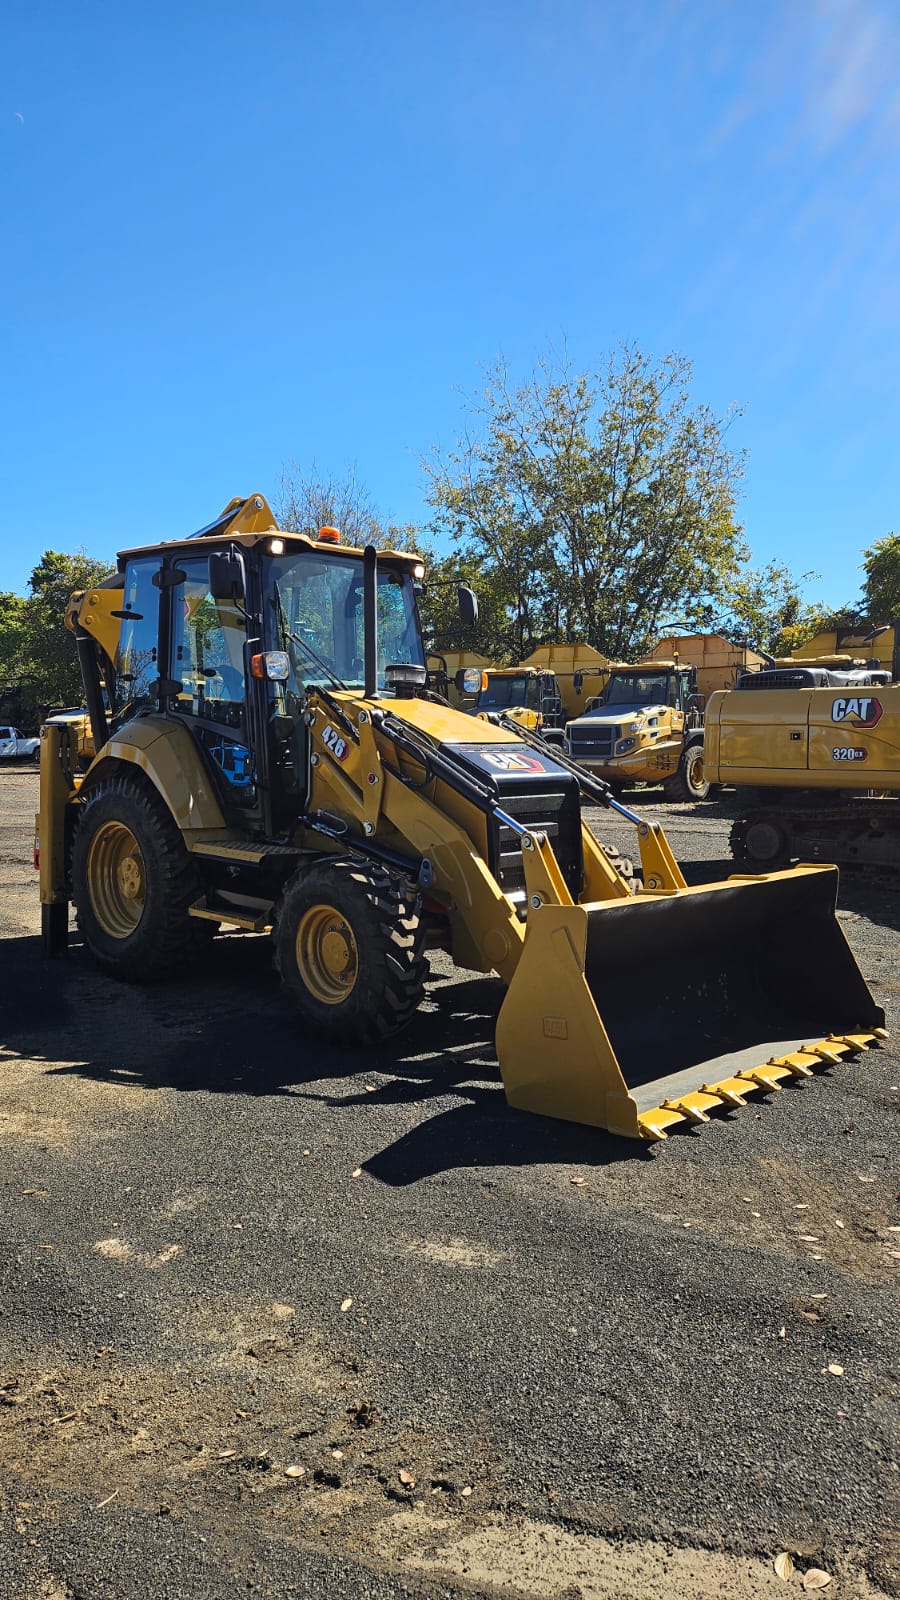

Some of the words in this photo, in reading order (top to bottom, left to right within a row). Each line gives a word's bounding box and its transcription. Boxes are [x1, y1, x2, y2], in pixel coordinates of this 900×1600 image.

[832, 698, 871, 721] CAT
[322, 725, 346, 757] 426
[480, 753, 531, 769] CAT
